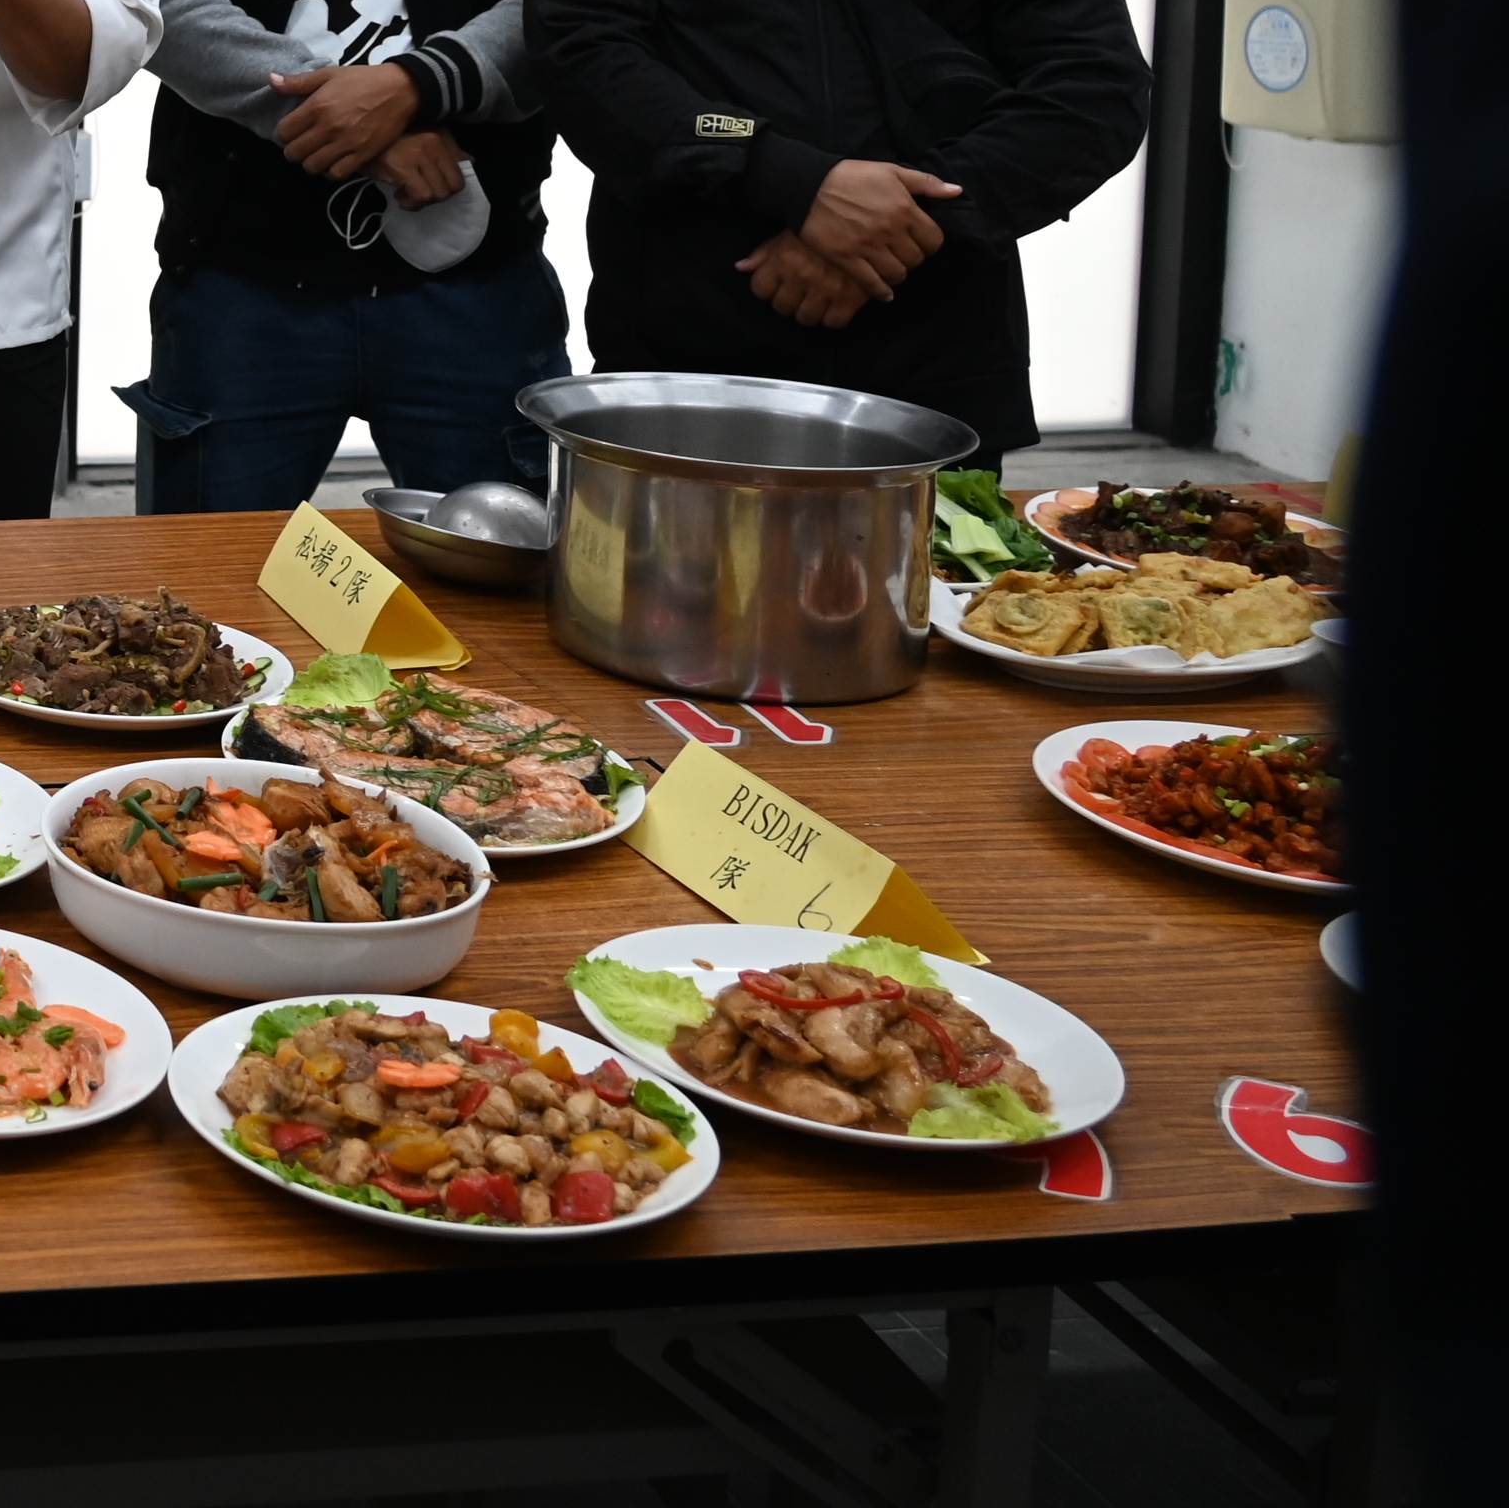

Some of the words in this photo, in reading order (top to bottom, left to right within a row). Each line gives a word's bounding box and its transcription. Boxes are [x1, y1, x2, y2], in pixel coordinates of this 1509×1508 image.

[721, 784, 822, 864] BISDAK
[709, 856, 752, 890] 隊
[797, 882, 832, 932] 6
